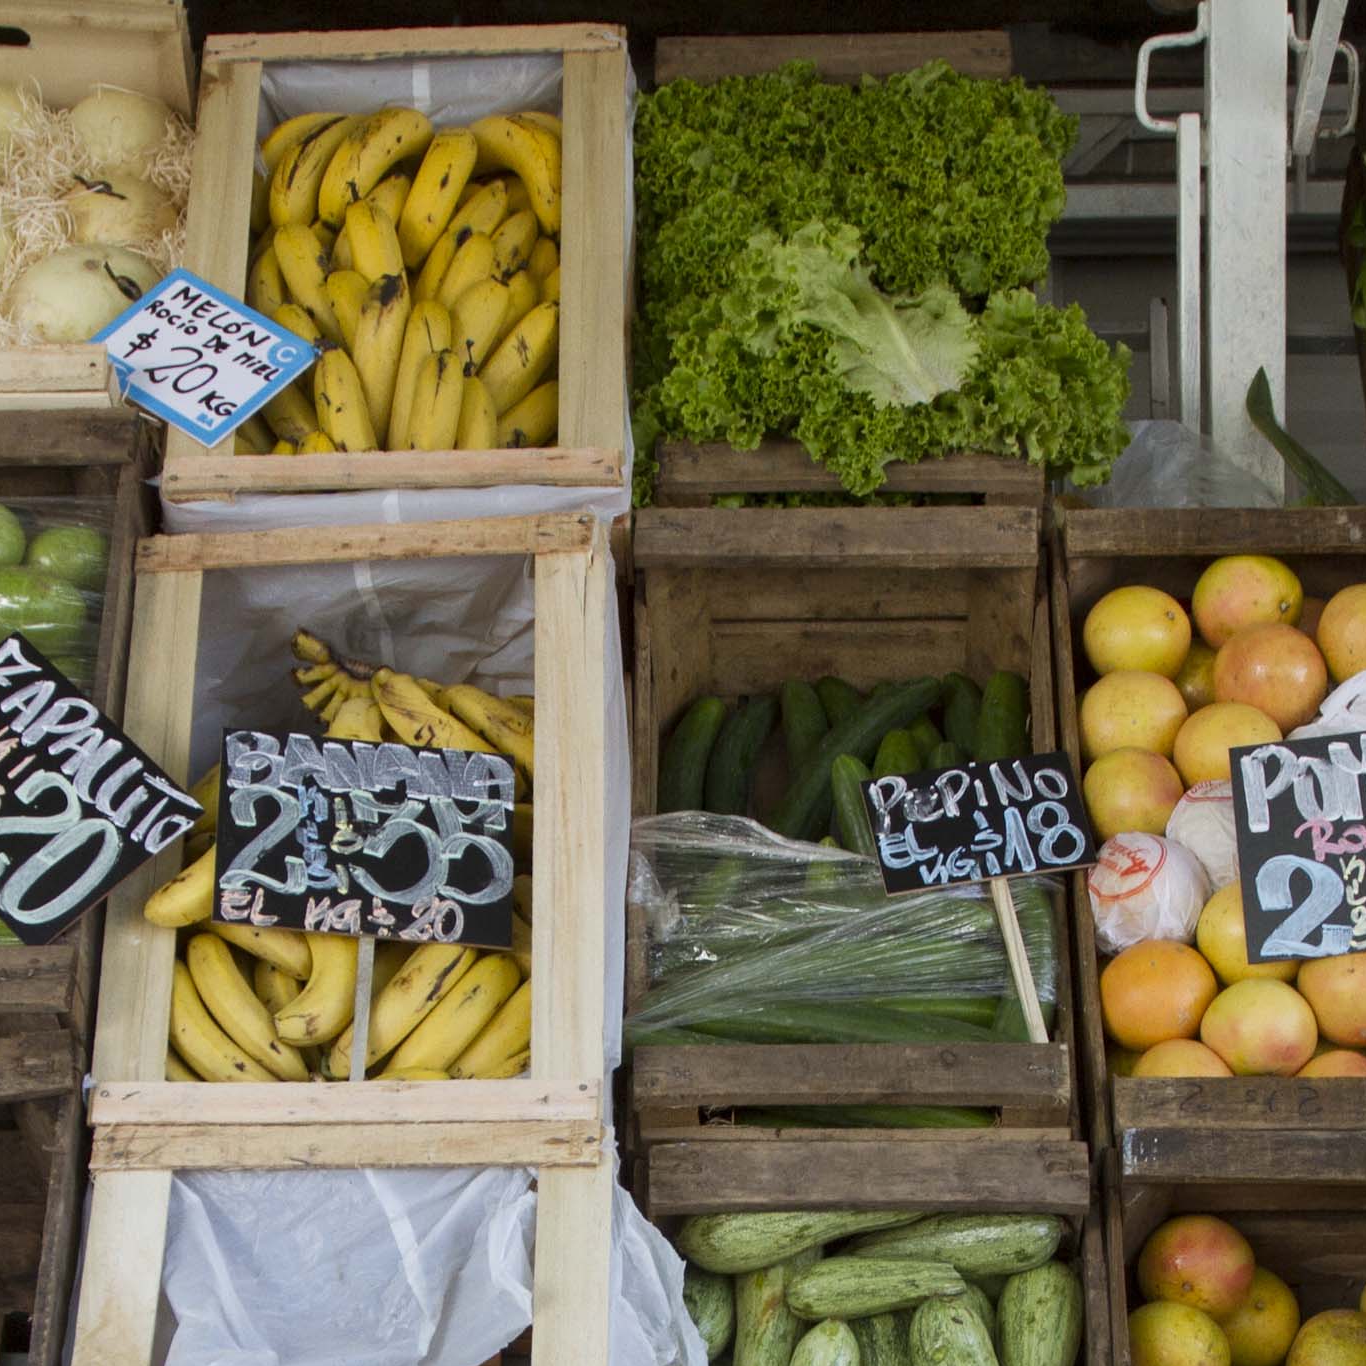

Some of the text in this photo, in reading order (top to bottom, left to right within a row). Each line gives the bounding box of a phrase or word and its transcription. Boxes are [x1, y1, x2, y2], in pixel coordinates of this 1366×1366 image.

[170, 286, 271, 347] MELÓN
[226, 730, 515, 811] BANANA
[219, 784, 307, 896] 2
[1255, 854, 1353, 957] 2
